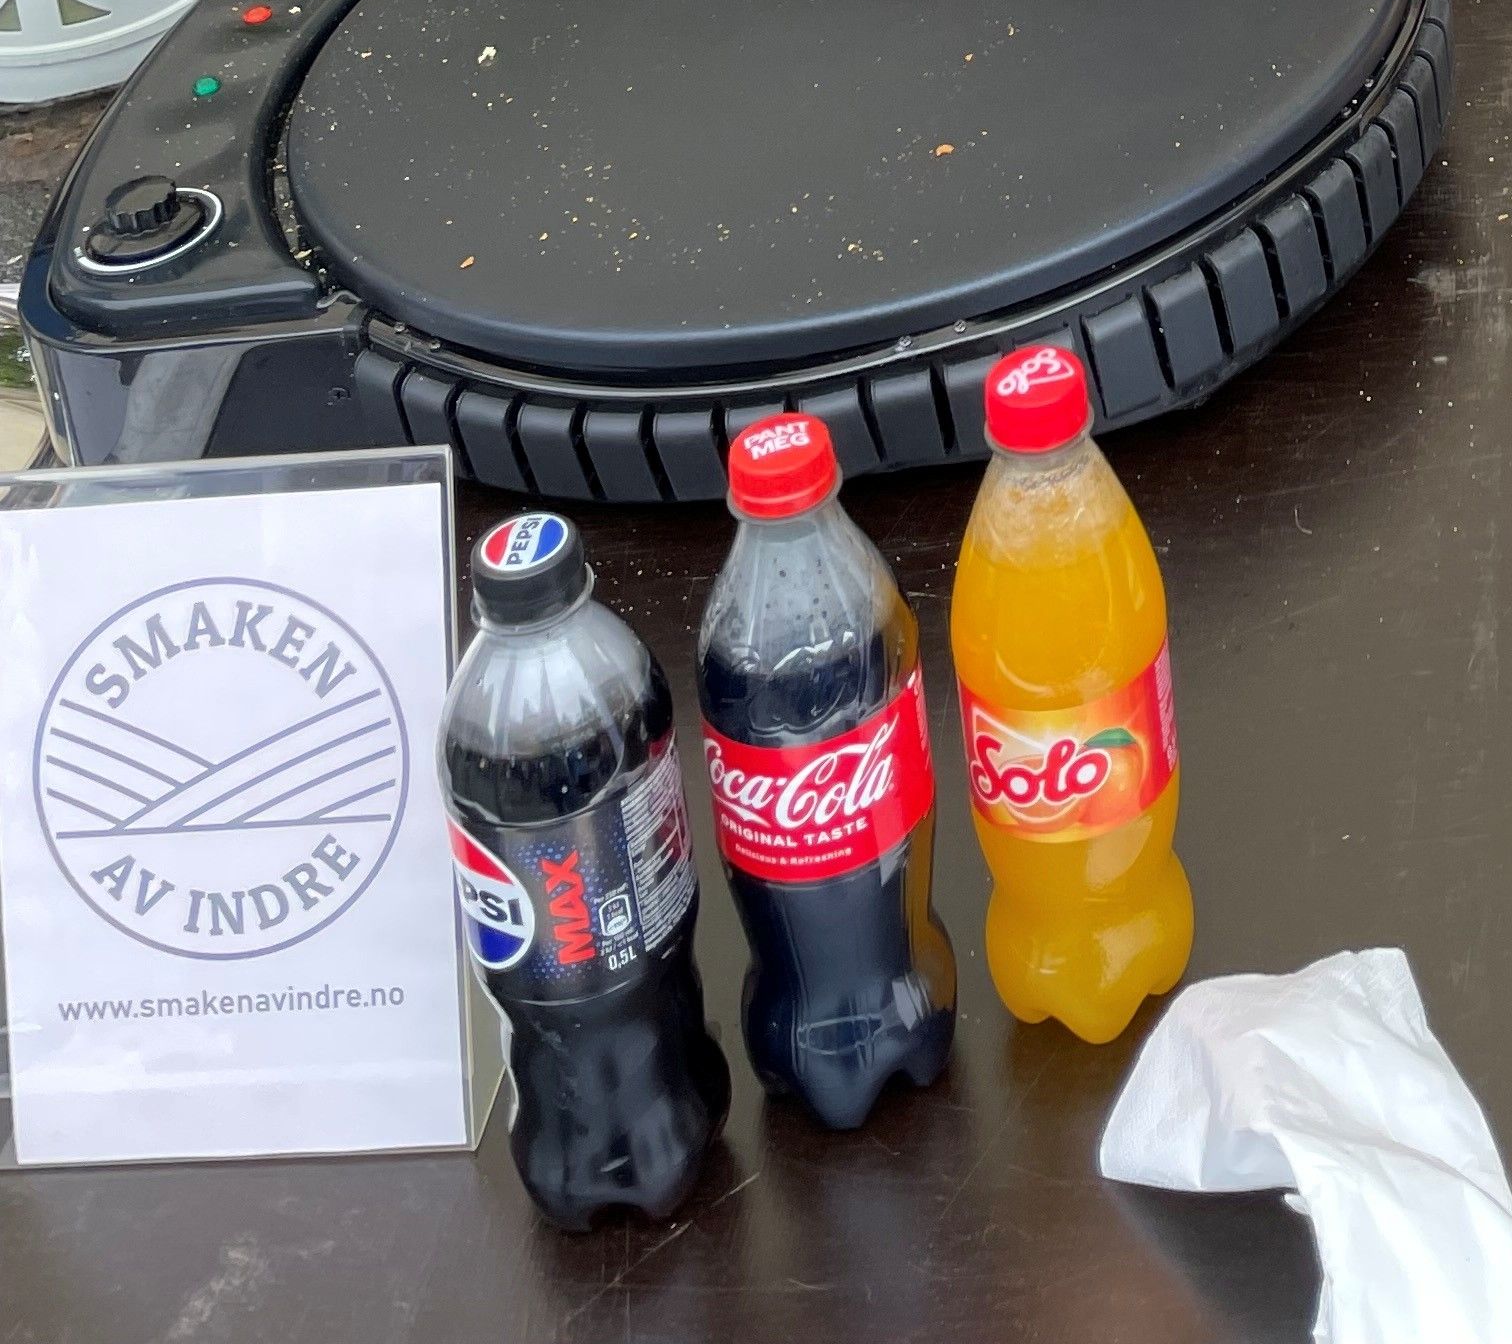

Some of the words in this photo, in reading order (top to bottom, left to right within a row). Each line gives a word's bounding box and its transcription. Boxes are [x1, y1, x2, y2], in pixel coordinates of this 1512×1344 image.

[997, 348, 1061, 396] Solo
[744, 421, 809, 449] PANT
[750, 433, 811, 460] MEG
[506, 517, 542, 565] PEPSI
[85, 600, 357, 709] SMAKEN
[704, 714, 899, 829] Coca-Cola
[970, 731, 1112, 806] Solo
[721, 813, 798, 848] ORIGINAL
[803, 816, 868, 846] TASTE
[90, 853, 175, 916] AV
[183, 833, 360, 937] INDRE
[459, 872, 523, 926] PSI
[541, 849, 596, 965] MAX
[58, 984, 405, 1021] www.smakenavindre.no
